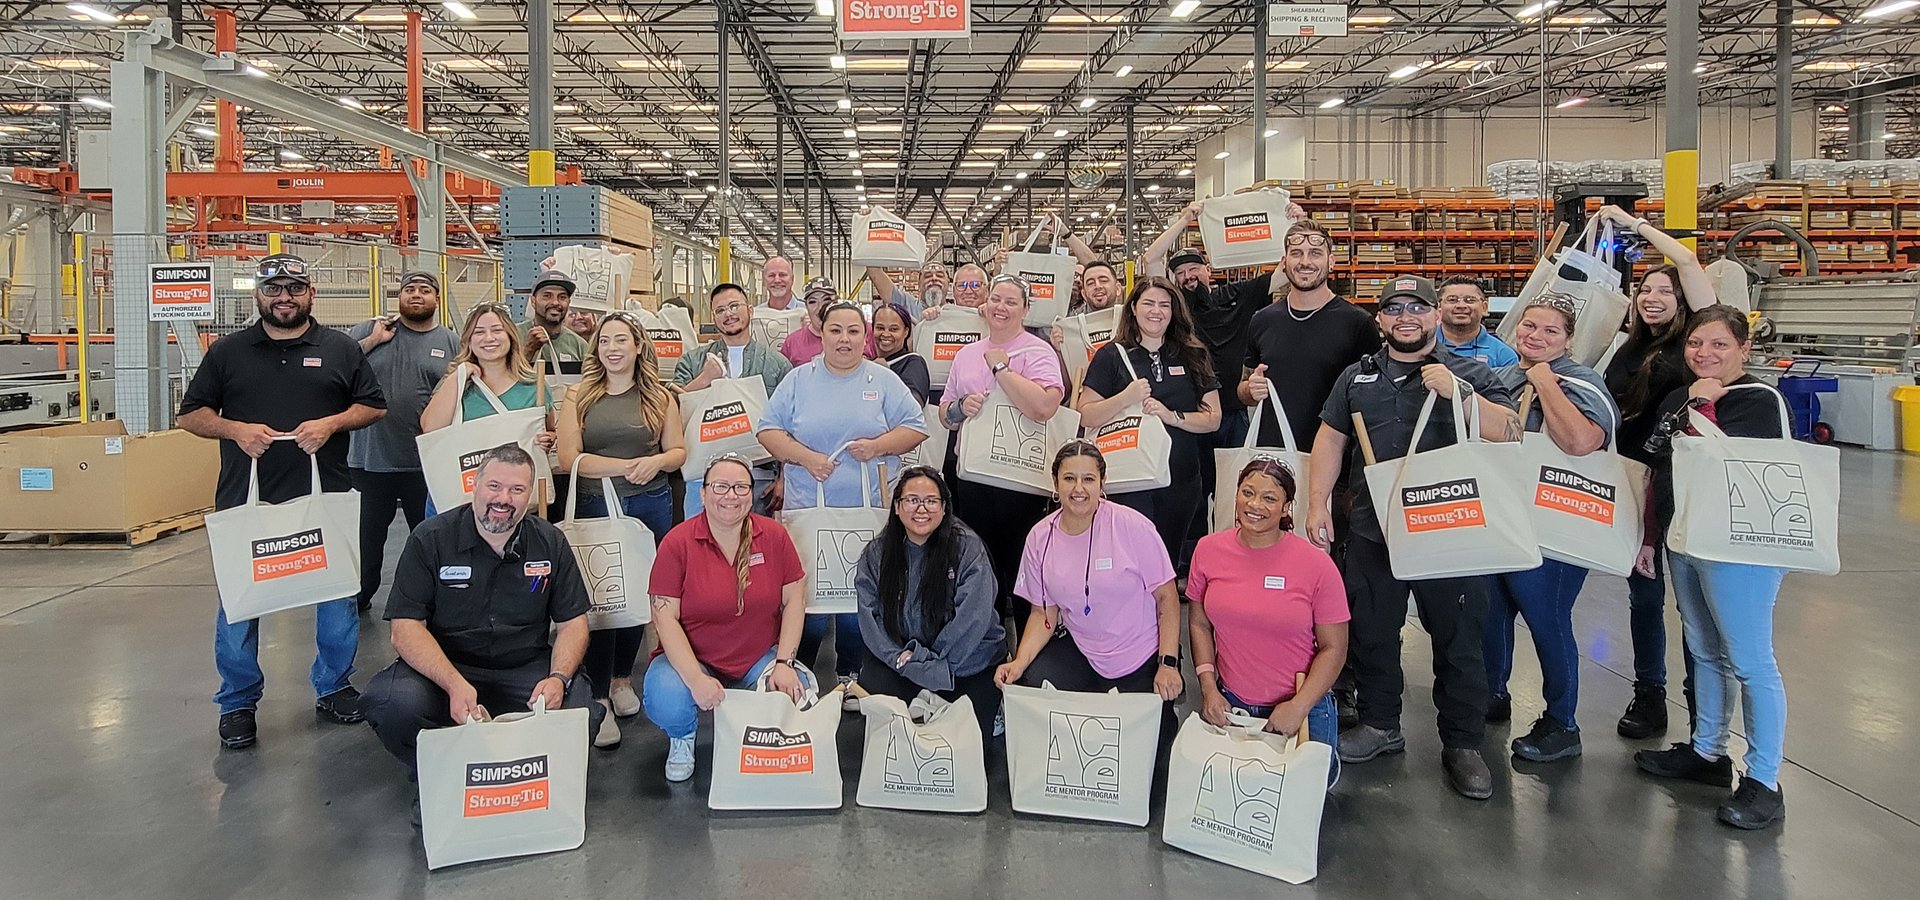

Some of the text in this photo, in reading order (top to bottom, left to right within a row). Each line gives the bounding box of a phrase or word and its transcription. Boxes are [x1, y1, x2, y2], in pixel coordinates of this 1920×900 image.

[850, 1, 958, 23] Strong-Tie
[292, 179, 324, 187] JOULIN
[1227, 215, 1266, 225] SIMPSON
[1227, 229, 1269, 238] Strong-Tie
[156, 270, 207, 279] SIMPSON
[155, 288, 208, 299] Strong-Tie
[703, 420, 748, 436] Strong-Tie
[1100, 419, 1138, 435] SIMPSON
[1000, 456, 1020, 464] MENTOR
[1021, 460, 1044, 471] PROGRAM
[1545, 470, 1611, 498] SIMPSON
[1406, 483, 1474, 502] SIMPSON
[1540, 490, 1610, 517] Strong-Tie
[1409, 507, 1478, 525] Strong-Tie
[256, 532, 319, 554] SIMPSON
[1746, 534, 1776, 543] MENTOR
[1777, 537, 1814, 547] PROGRAM
[257, 554, 322, 574] Strong-Tie
[598, 603, 627, 612] PROGRAM
[748, 731, 806, 746] SIMPSON
[744, 753, 808, 769] Strong-Tie
[471, 761, 543, 782] SIMPSON
[897, 784, 922, 792] MENTOR
[924, 786, 955, 794] PROGRAM
[1045, 786, 1119, 800] ACE MENTOR PROGRAM
[469, 788, 544, 808] Strong-Tie
[1192, 816, 1273, 851] ACE MENTOR PROGRAM
